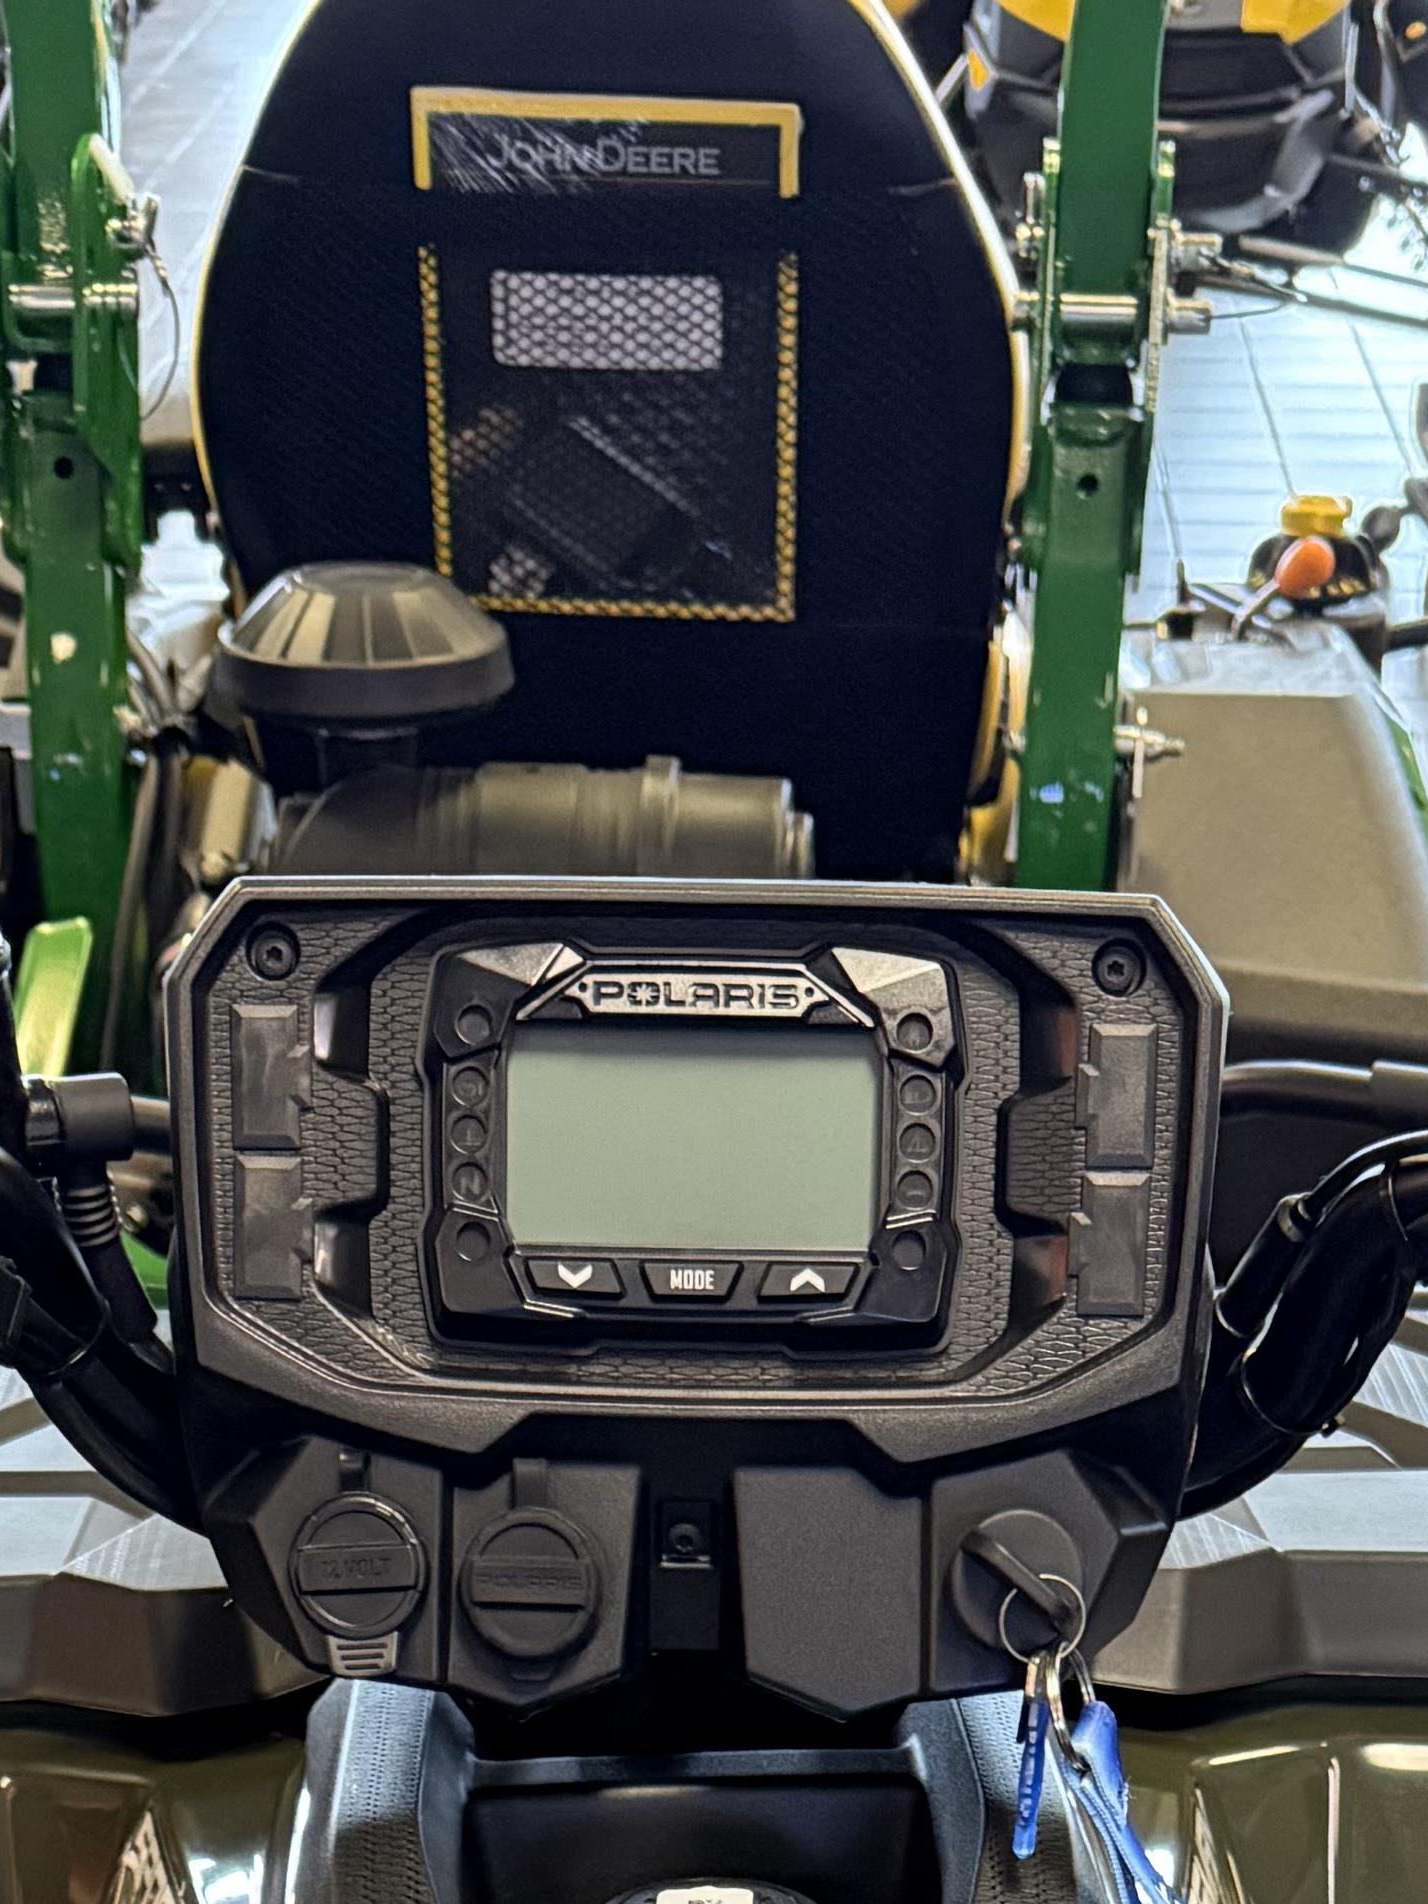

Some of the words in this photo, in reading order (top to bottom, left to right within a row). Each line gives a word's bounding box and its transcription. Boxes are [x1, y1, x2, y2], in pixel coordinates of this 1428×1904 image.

[485, 134, 596, 174] JOHN
[597, 136, 722, 176] DEERE
[591, 980, 800, 1011] POLARIS
[669, 1268, 715, 1291] MODE
